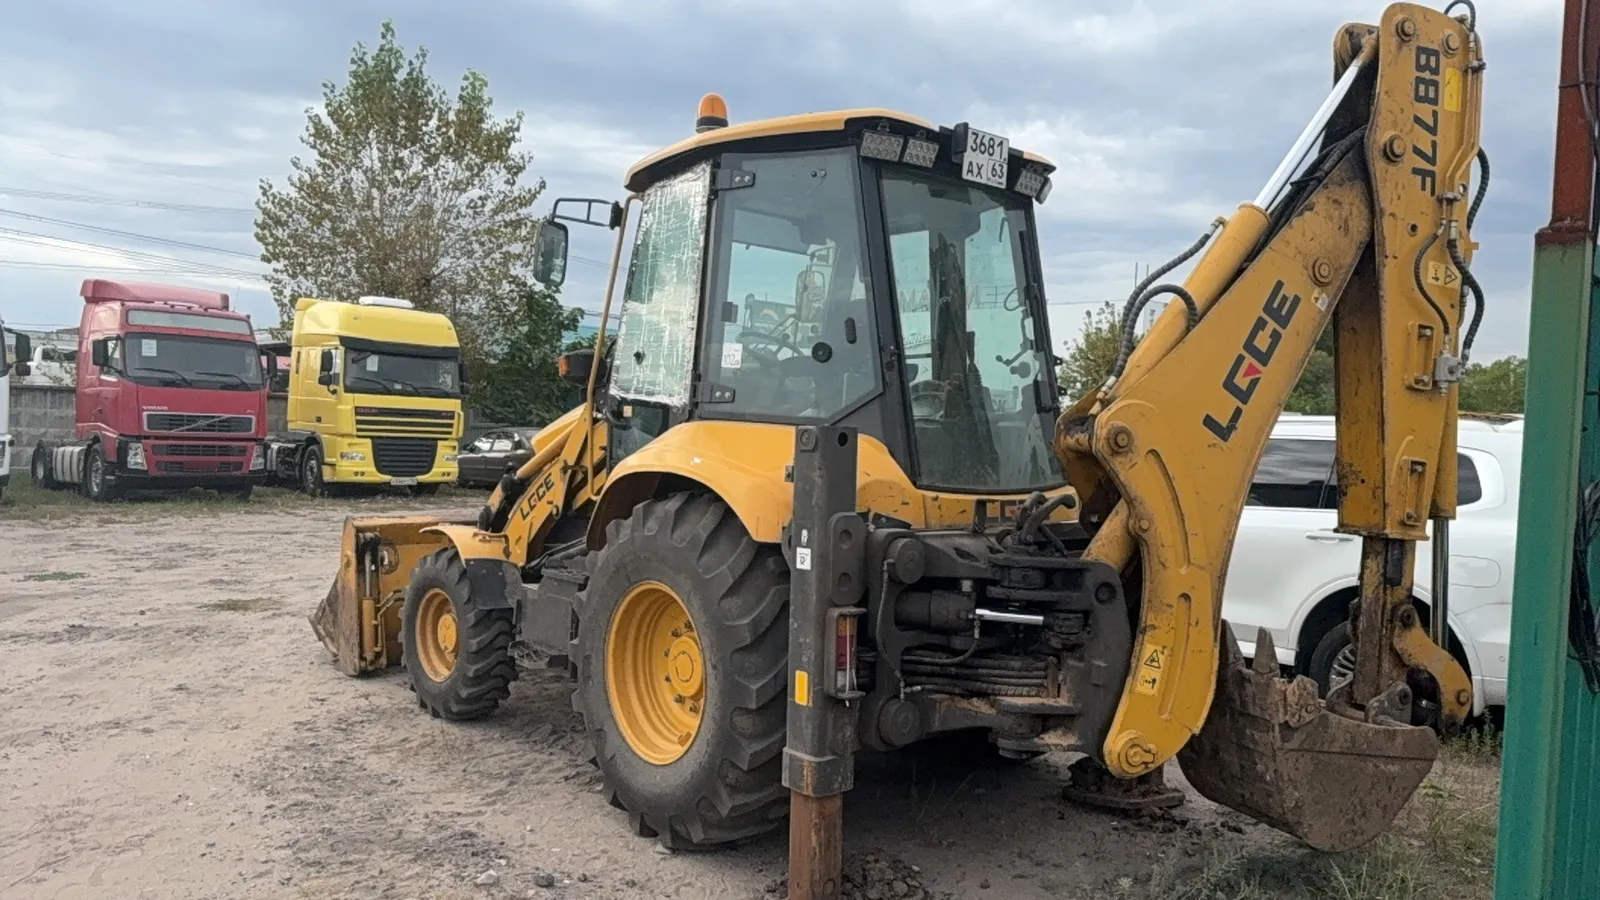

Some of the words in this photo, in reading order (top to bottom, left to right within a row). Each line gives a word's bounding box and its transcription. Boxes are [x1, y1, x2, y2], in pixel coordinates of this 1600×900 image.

[1411, 44, 1441, 197] B877F
[970, 131, 1004, 160] 3681
[991, 162, 1004, 179] 63
